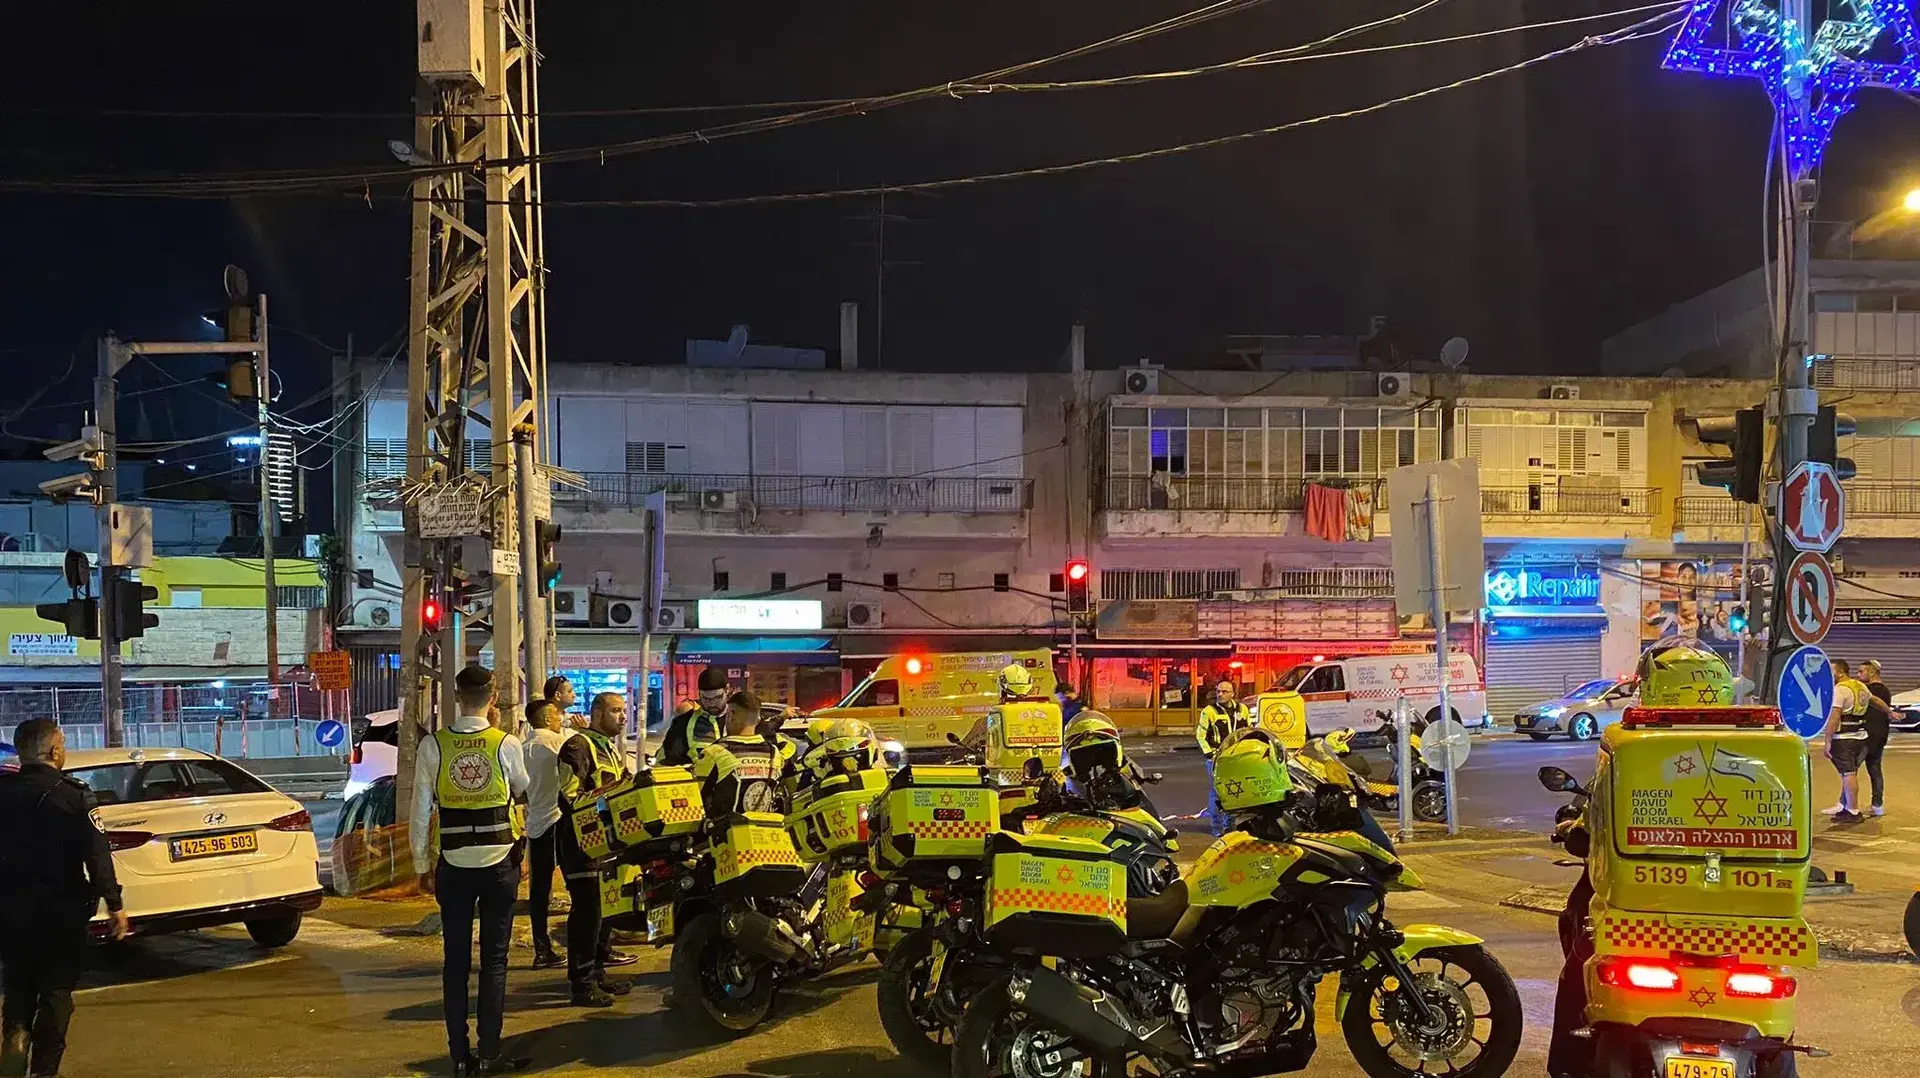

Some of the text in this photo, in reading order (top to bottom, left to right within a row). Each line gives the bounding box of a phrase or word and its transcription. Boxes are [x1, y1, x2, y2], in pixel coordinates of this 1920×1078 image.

[12, 634, 73, 645] תיווך צעירי
[453, 738, 486, 749] חובש
[1632, 789, 1673, 798] MAGEN
[1741, 789, 1793, 802] מגן דוד
[1632, 798, 1667, 807] DAVID
[1633, 807, 1668, 816] ADOM
[1757, 803, 1793, 814] אדום
[1632, 816, 1686, 825] IN ISRAEL
[1737, 813, 1793, 827] בישראל
[834, 824, 857, 839] 101
[1632, 828, 1793, 847] ארגון ההצלה הלאומי
[1634, 865, 1688, 885] 5139
[1731, 869, 1774, 888] 101
